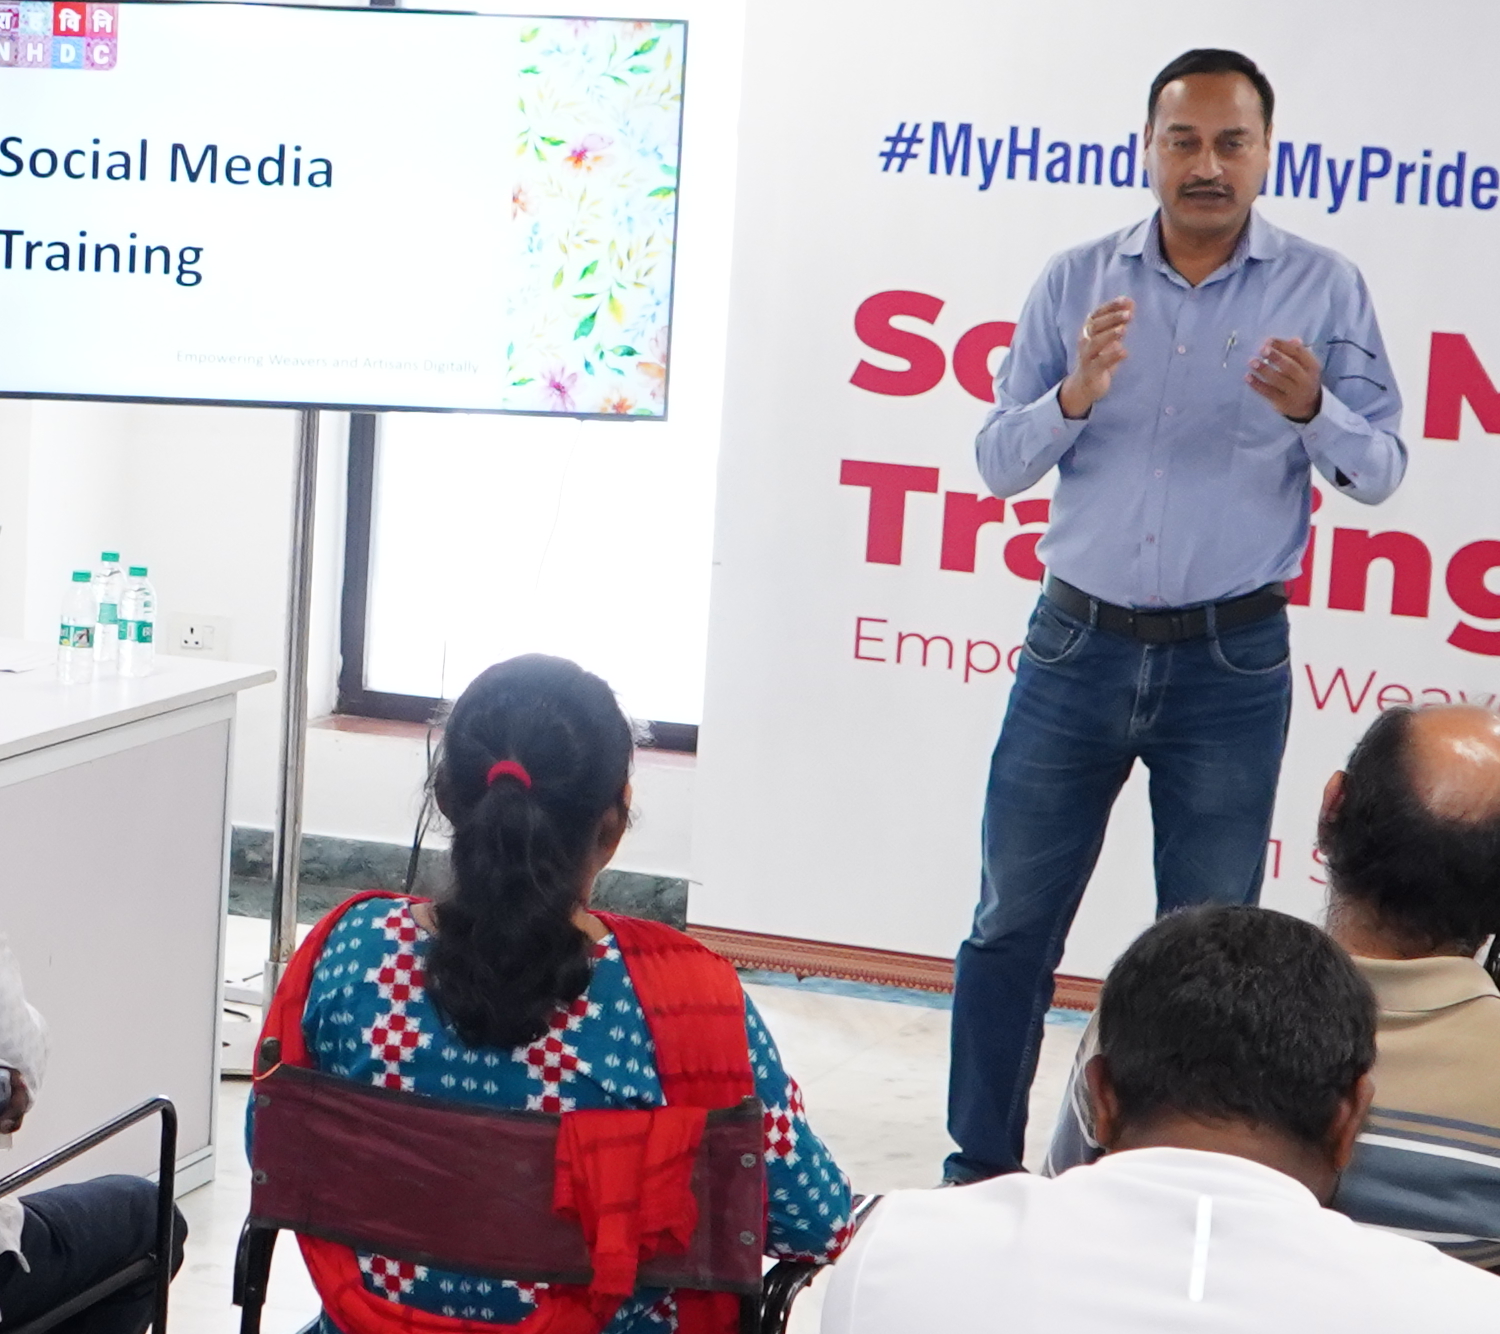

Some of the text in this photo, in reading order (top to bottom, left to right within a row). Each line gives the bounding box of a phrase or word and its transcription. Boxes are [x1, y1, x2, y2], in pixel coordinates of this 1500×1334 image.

[170, 143, 333, 188] Media
[879, 121, 1500, 214] #MyHandMyPride
[177, 350, 479, 374] Empowering Weavers and Artisans Digitally
